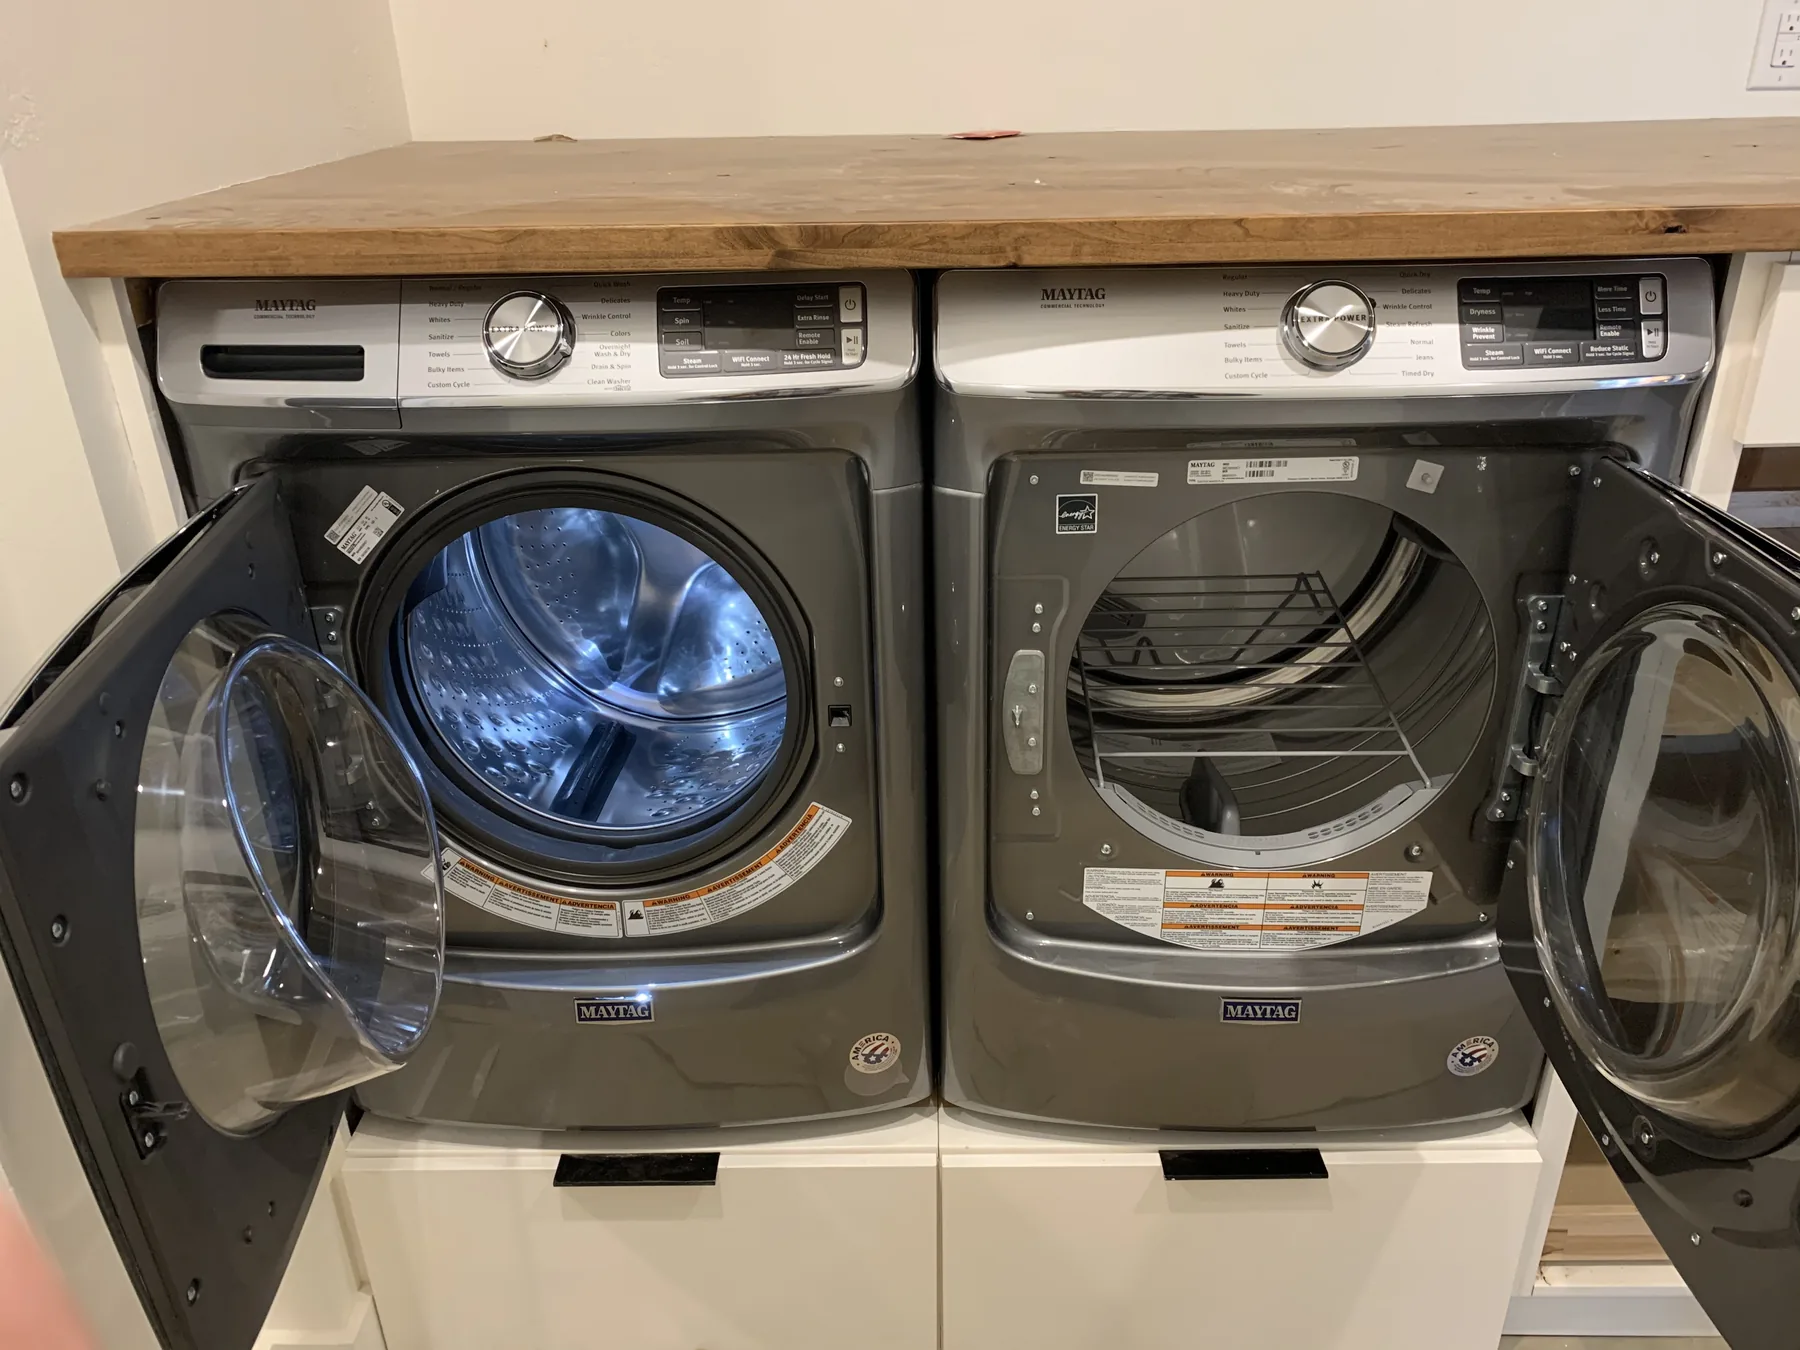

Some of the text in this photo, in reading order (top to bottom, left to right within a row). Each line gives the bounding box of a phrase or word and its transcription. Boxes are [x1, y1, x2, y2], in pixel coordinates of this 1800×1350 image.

[673, 296, 691, 304] Temp
[1041, 288, 1106, 300] MAYTAG
[255, 299, 316, 311] MAYTAG
[1470, 308, 1496, 316] Dryness
[341, 531, 357, 550] MAYTAG
[779, 814, 813, 850] ADVERTENCIA
[465, 863, 495, 882] WARNING
[712, 861, 763, 891] AVERTISSEMENT
[505, 882, 559, 903] AVERTISSEMENT
[566, 901, 614, 909] ADVERTENCIA
[657, 895, 690, 905] WARNING
[580, 1004, 649, 1018] MAYTAG
[1226, 1005, 1296, 1018] MAYTAG
[852, 1034, 889, 1060] AMERICA
[1451, 1038, 1494, 1058] AMERICA
